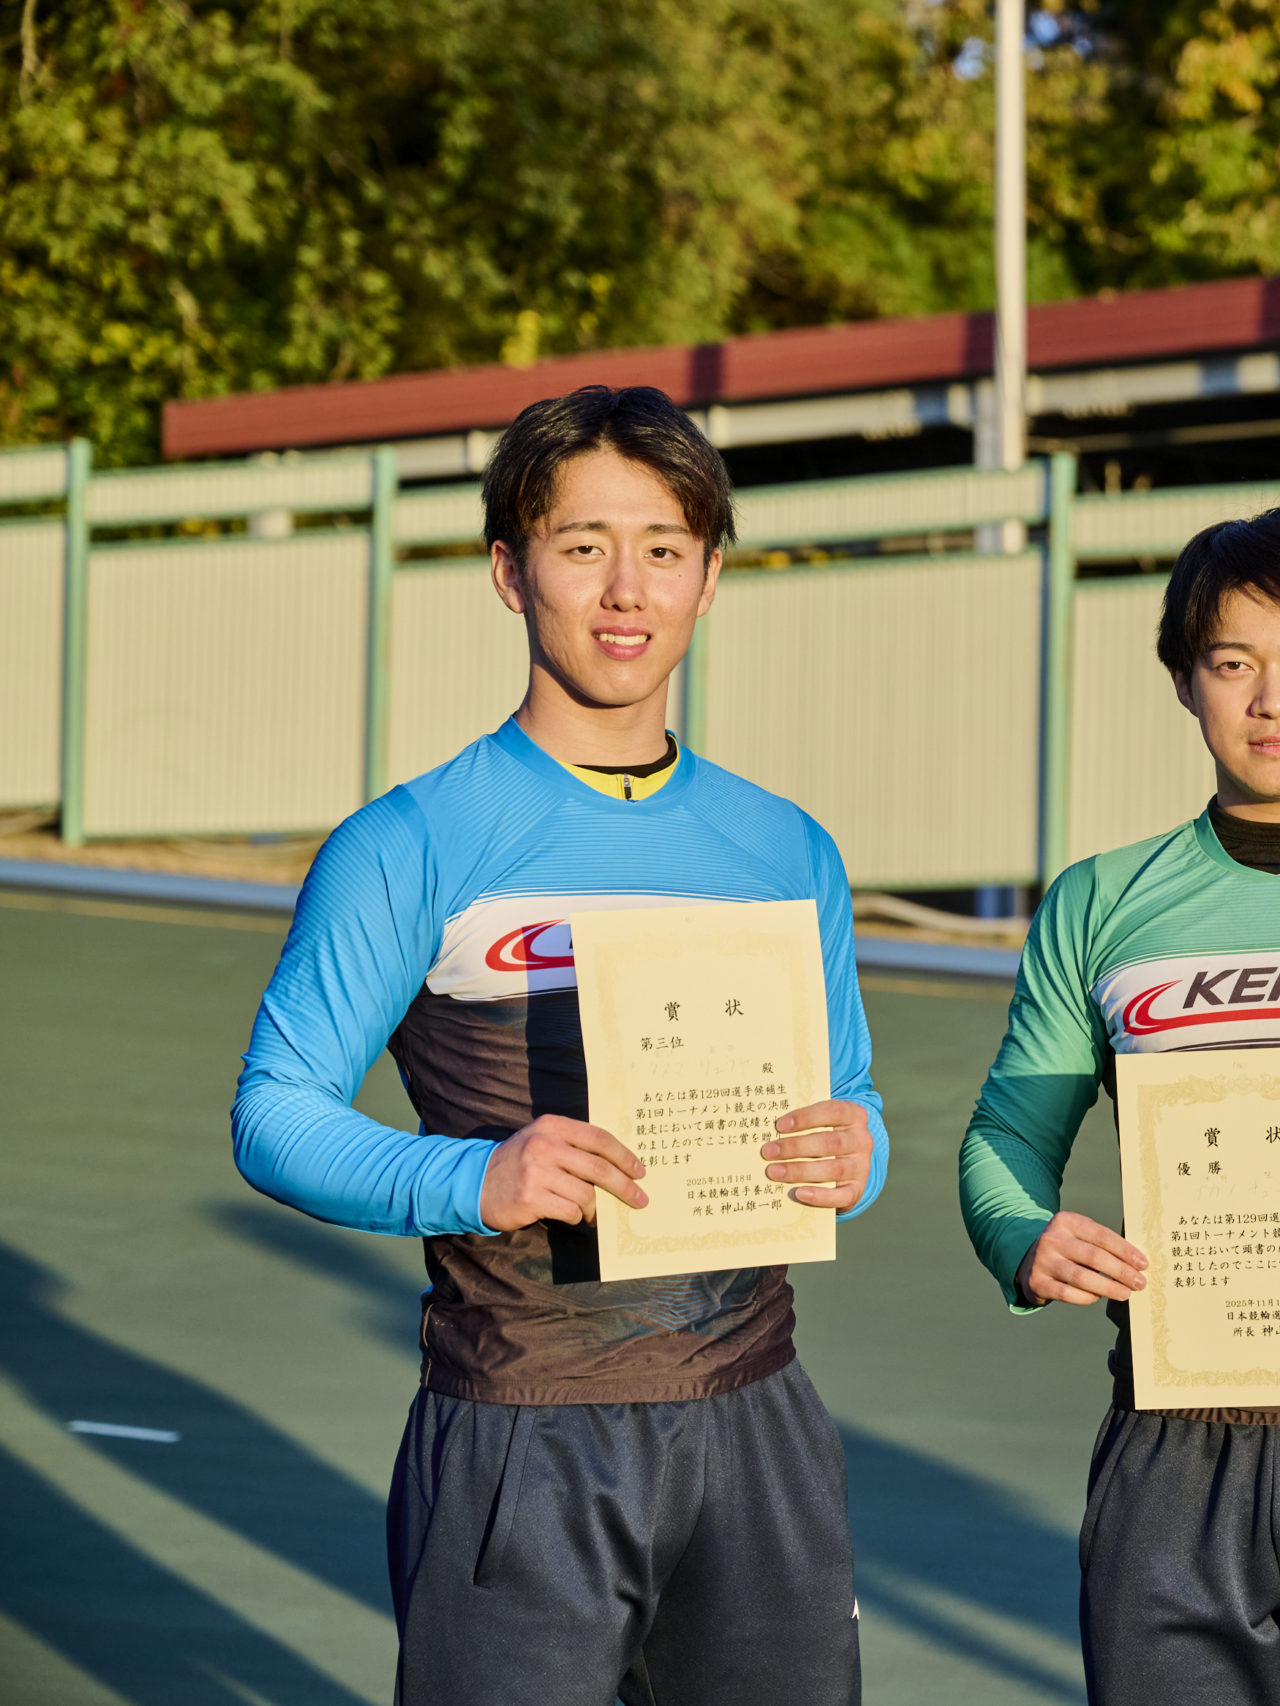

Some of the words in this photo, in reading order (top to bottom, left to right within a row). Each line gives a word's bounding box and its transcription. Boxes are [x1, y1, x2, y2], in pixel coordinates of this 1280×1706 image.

[640, 1036, 685, 1052] 第三位
[693, 1204, 714, 1217] 所長
[1233, 1326, 1256, 1338] 所長
